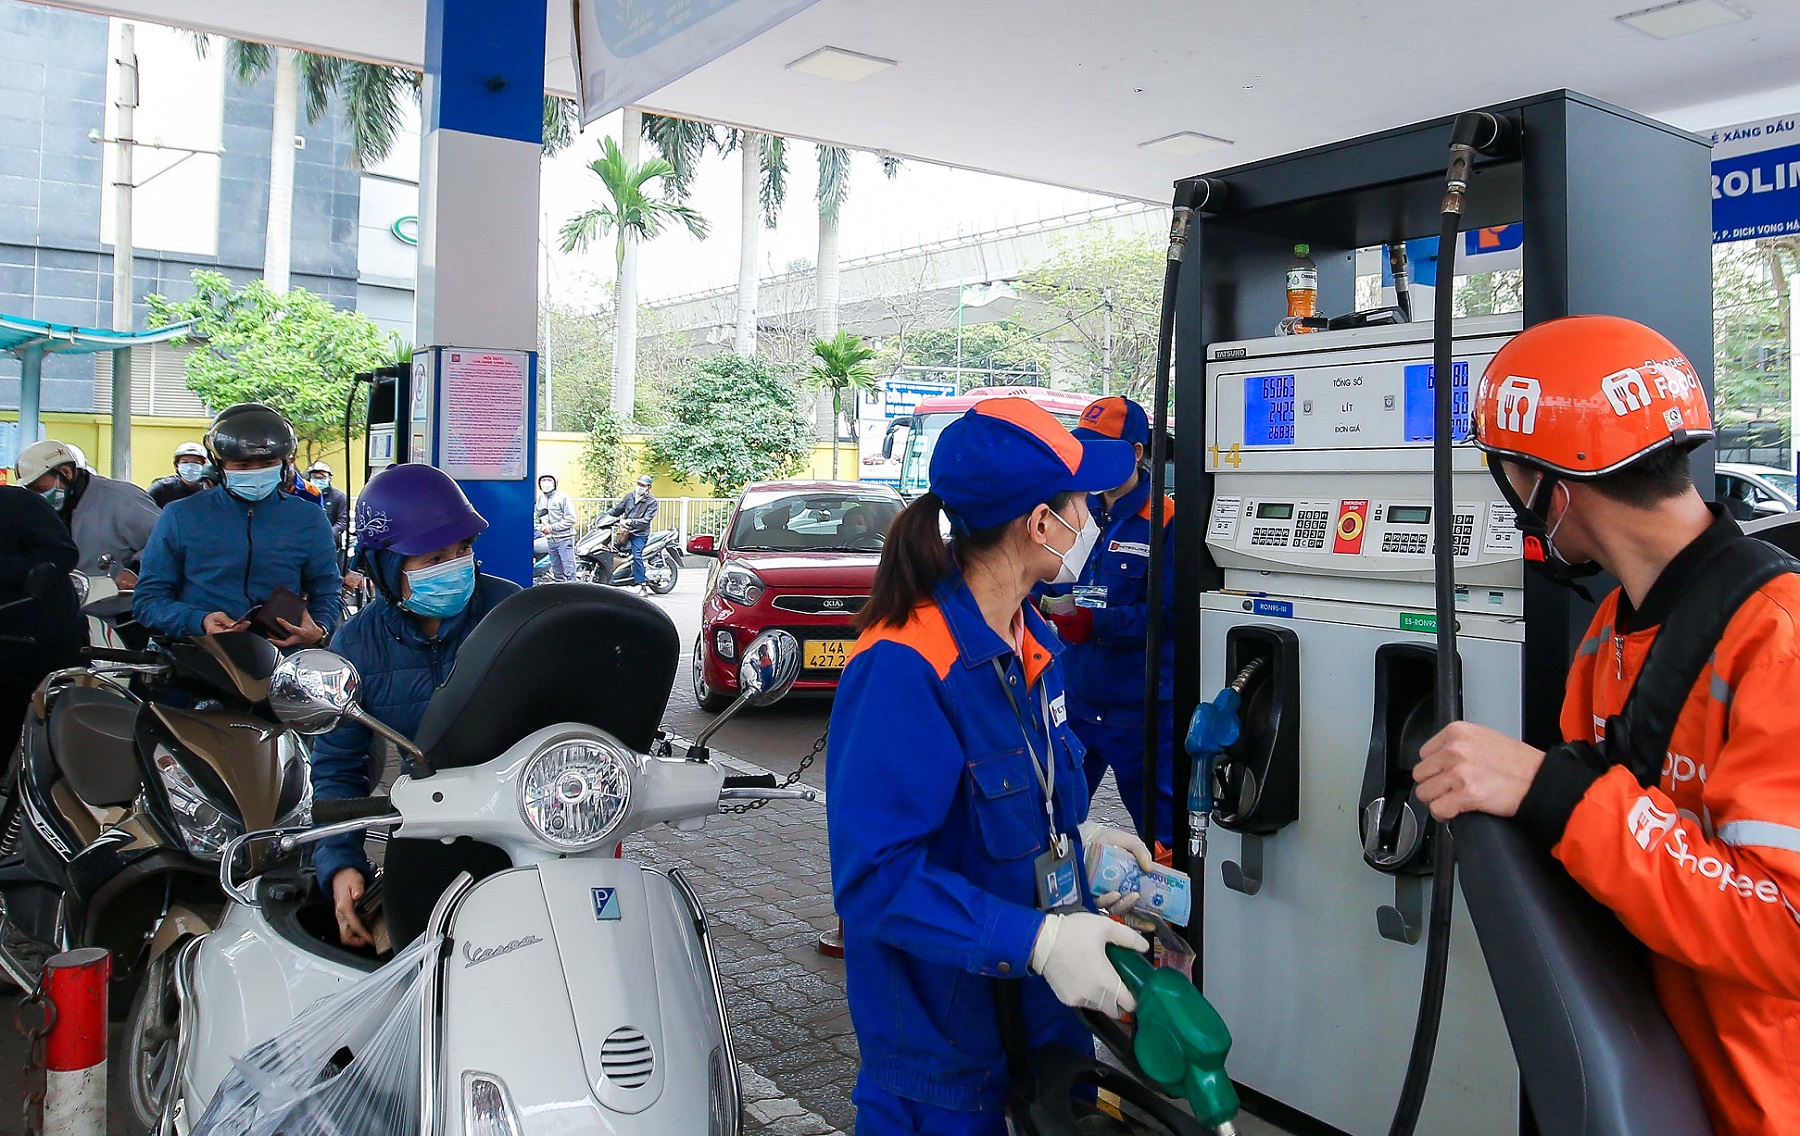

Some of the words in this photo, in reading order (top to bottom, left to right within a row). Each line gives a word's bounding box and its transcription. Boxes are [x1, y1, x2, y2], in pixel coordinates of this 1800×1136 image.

[1216, 350, 1245, 358] TATSUNO
[1644, 356, 1687, 375] Shopee
[1262, 377, 1295, 399] 65063
[1352, 376, 1363, 386] SỐ
[1653, 367, 1698, 399] Food
[1341, 401, 1353, 413] LÍT
[1268, 425, 1295, 440] 26830
[1208, 443, 1242, 469] 14
[1260, 603, 1287, 613] RON95-III
[822, 642, 844, 654] 14A
[810, 655, 849, 667] 427.2
[1664, 828, 1779, 903] Shopee
[464, 935, 544, 969] Vespa
